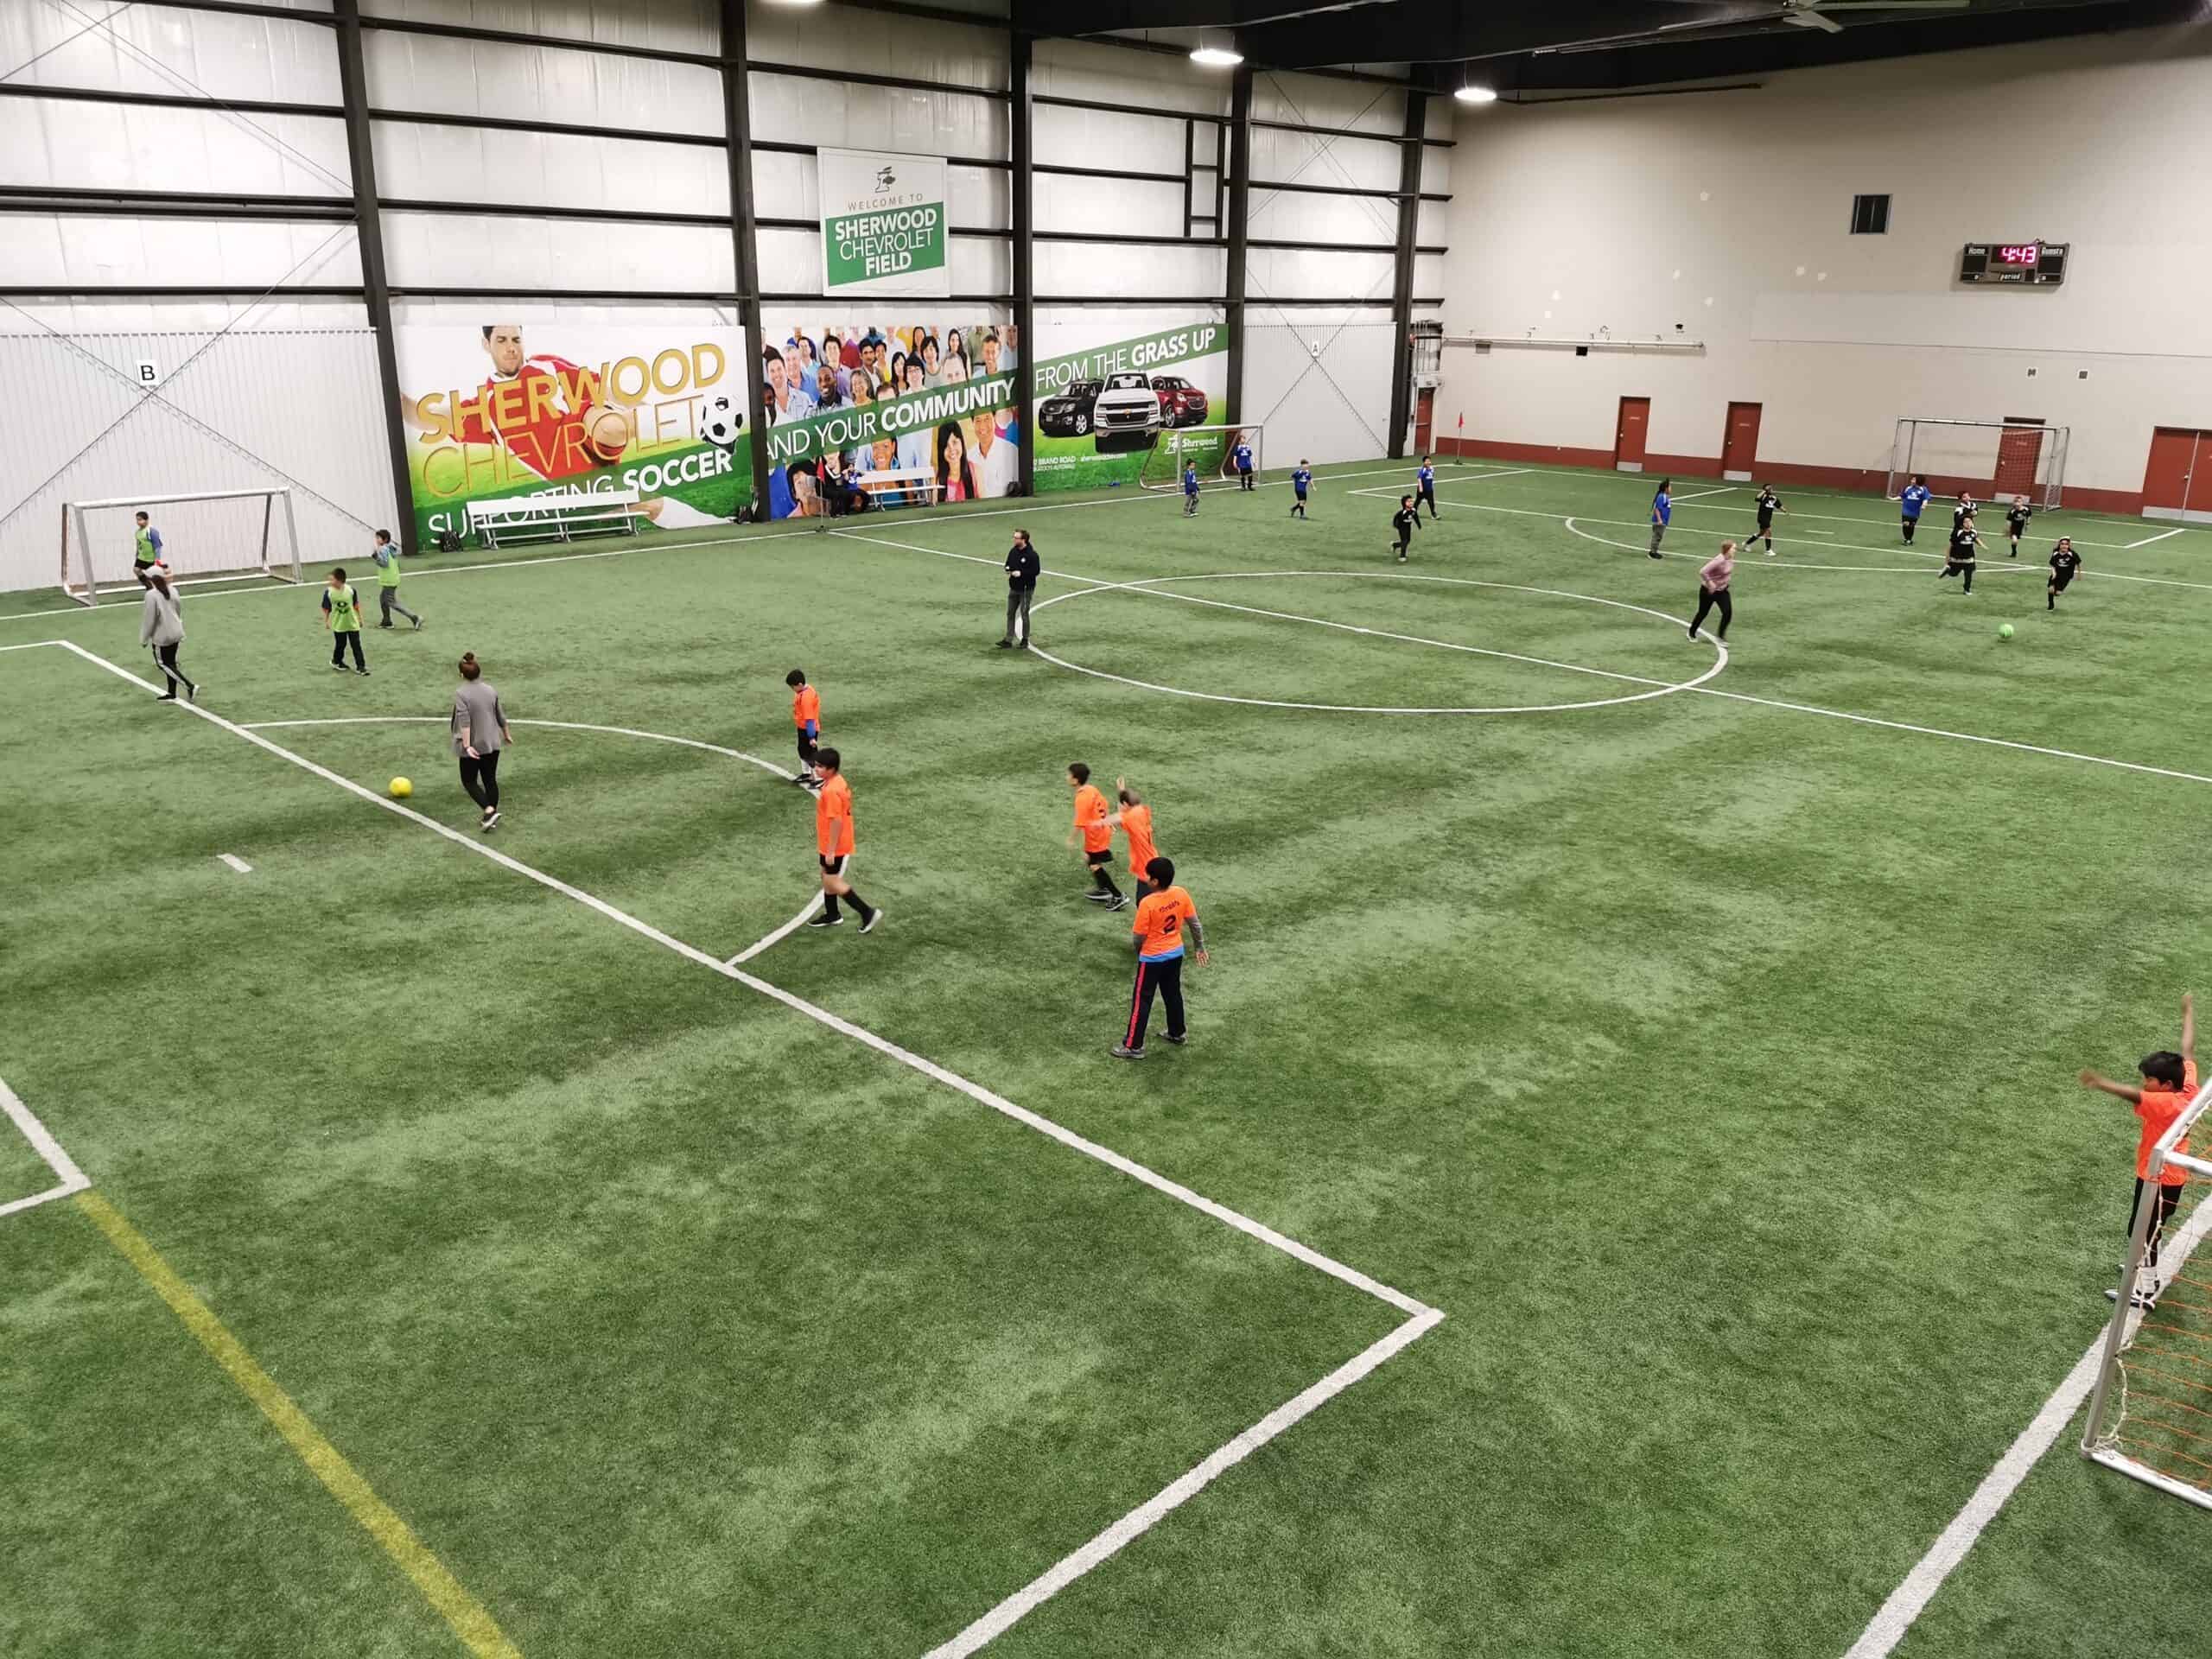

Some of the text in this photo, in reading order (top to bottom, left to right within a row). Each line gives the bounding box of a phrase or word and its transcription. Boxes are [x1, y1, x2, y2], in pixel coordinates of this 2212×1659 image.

[848, 193, 924, 211] WELCOME TO
[835, 208, 938, 241] SHERWOOD
[840, 228, 934, 260] CHEVROLET
[2002, 245, 2037, 263] 4:43
[865, 251, 912, 276] FIELD
[140, 365, 156, 381] B
[1035, 327, 1216, 391] FROM THE GRASS UP
[416, 343, 727, 442] SHERWOOD
[815, 411, 877, 448] YOUR
[880, 377, 1016, 431] COMMUNITY
[423, 394, 704, 498] CHEVROLET
[623, 450, 734, 493] SOCCER
[1163, 914, 1176, 934] 2
